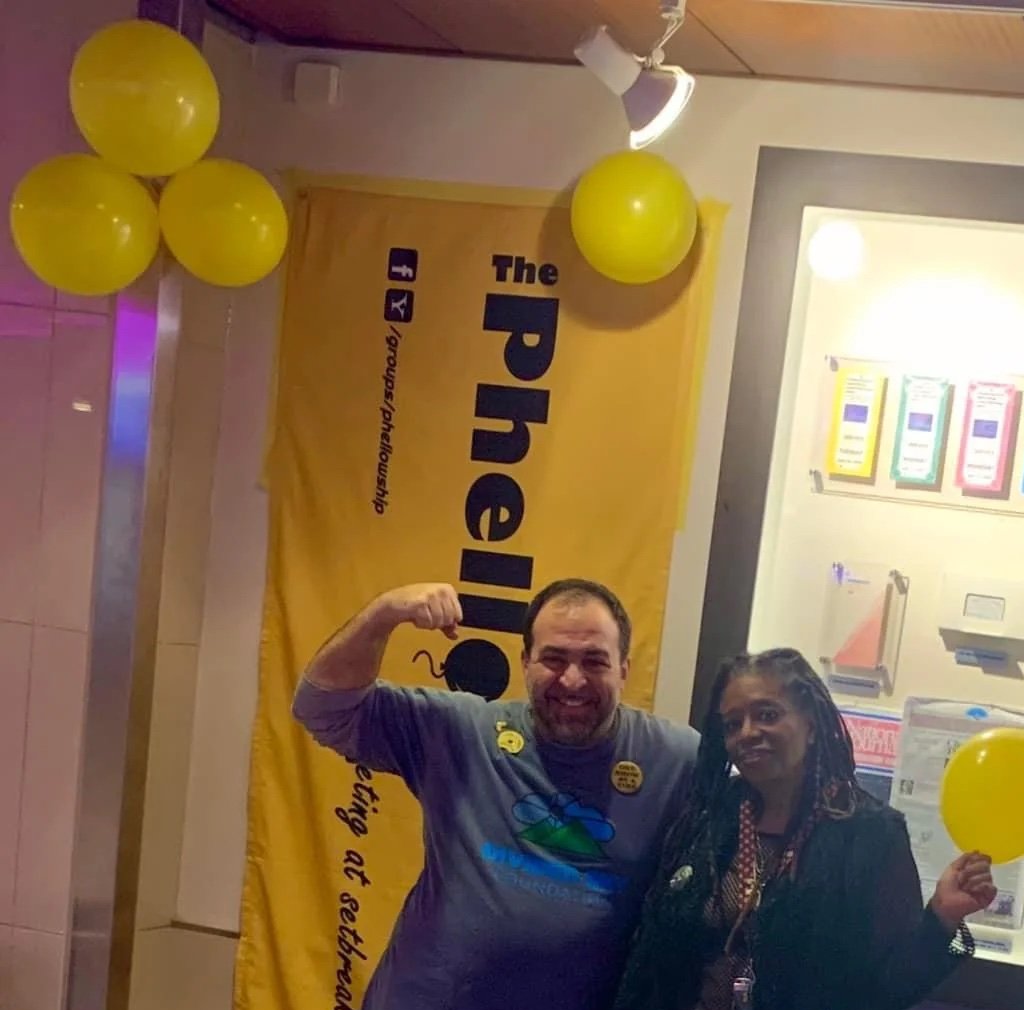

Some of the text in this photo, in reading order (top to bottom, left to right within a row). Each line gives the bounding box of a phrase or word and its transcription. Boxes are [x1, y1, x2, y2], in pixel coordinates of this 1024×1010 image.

[492, 254, 560, 287] The
[373, 325, 403, 515] /groups/phellowship
[445, 293, 561, 702] Phello
[335, 765, 385, 838] eting
[343, 846, 372, 887] at
